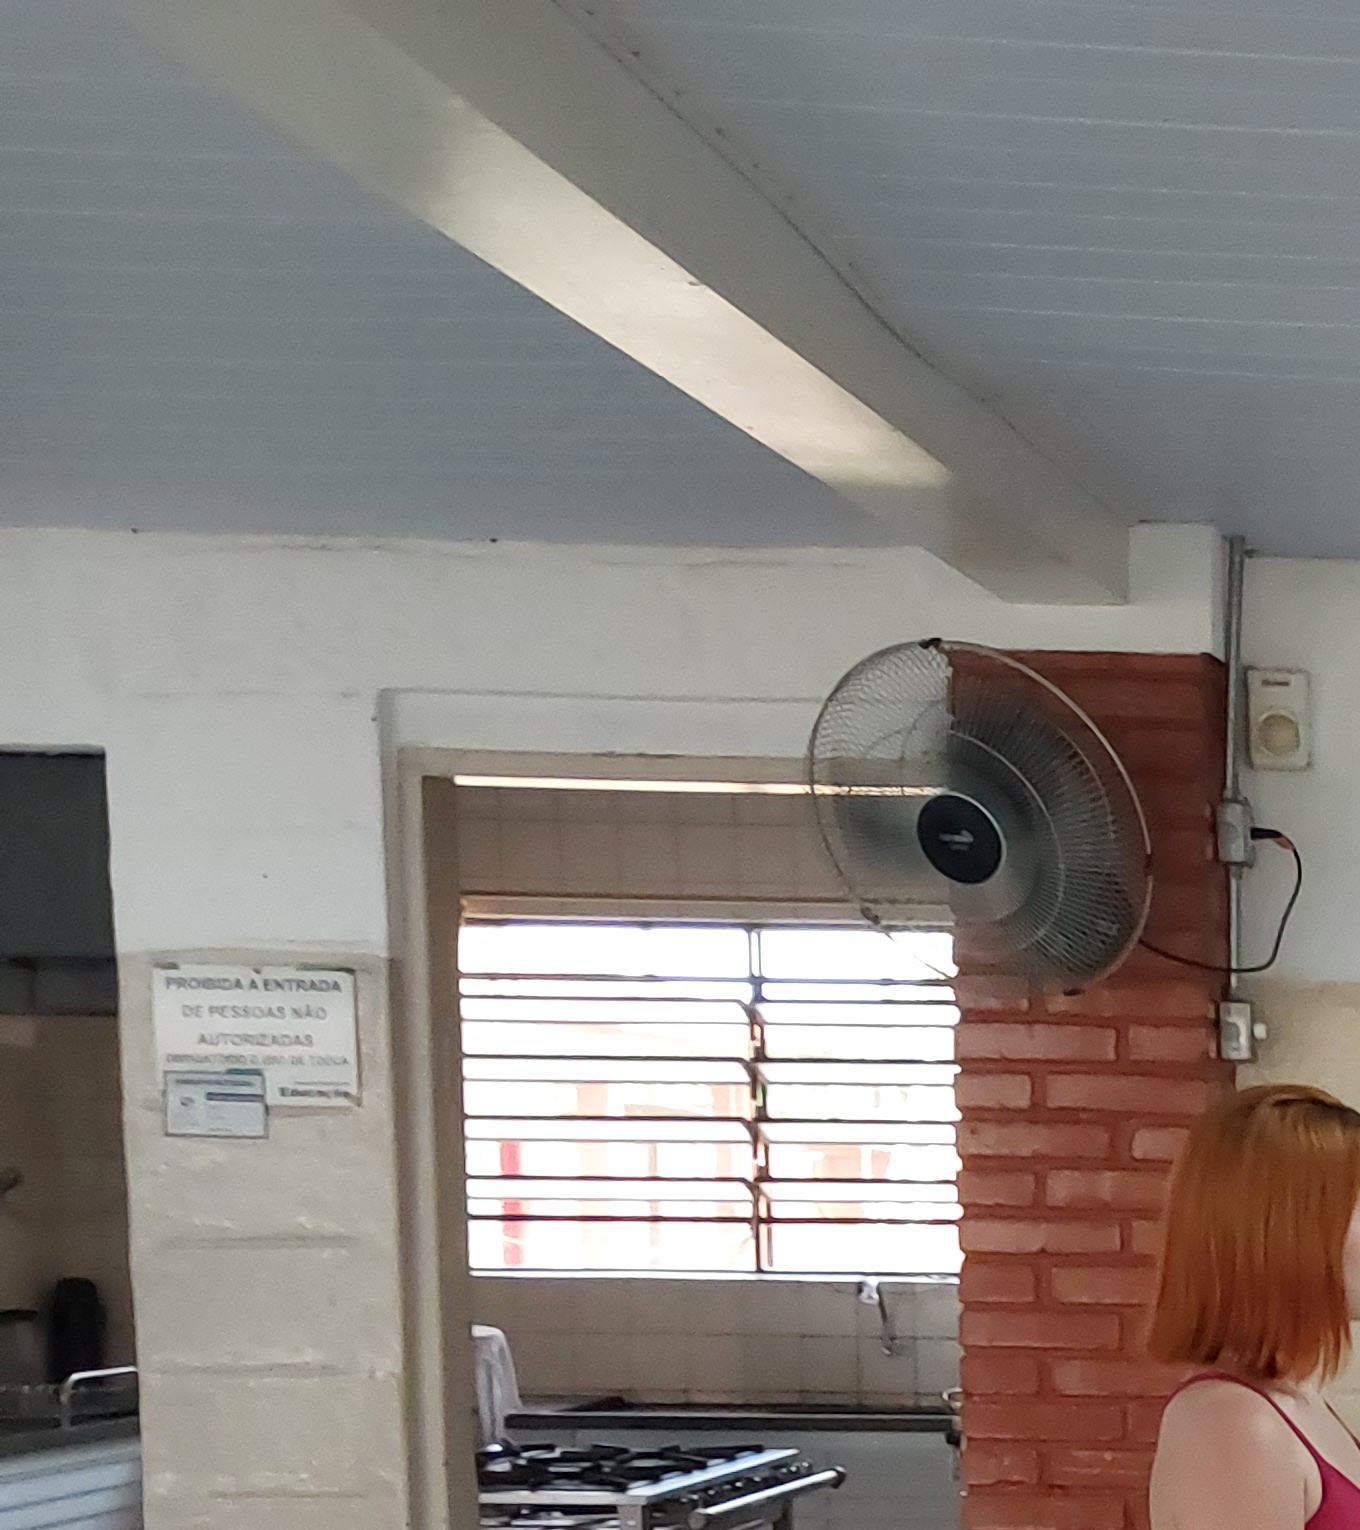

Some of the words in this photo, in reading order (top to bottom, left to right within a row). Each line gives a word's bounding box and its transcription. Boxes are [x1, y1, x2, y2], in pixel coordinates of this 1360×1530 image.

[165, 976, 244, 991] PROIBIDA
[249, 977, 260, 992] A
[263, 978, 343, 993] ENTRADA
[181, 1004, 203, 1018] DE
[208, 1004, 287, 1019] PESSOAS
[291, 1003, 327, 1020] NÃO
[197, 1032, 314, 1048] AUTORIZADAS
